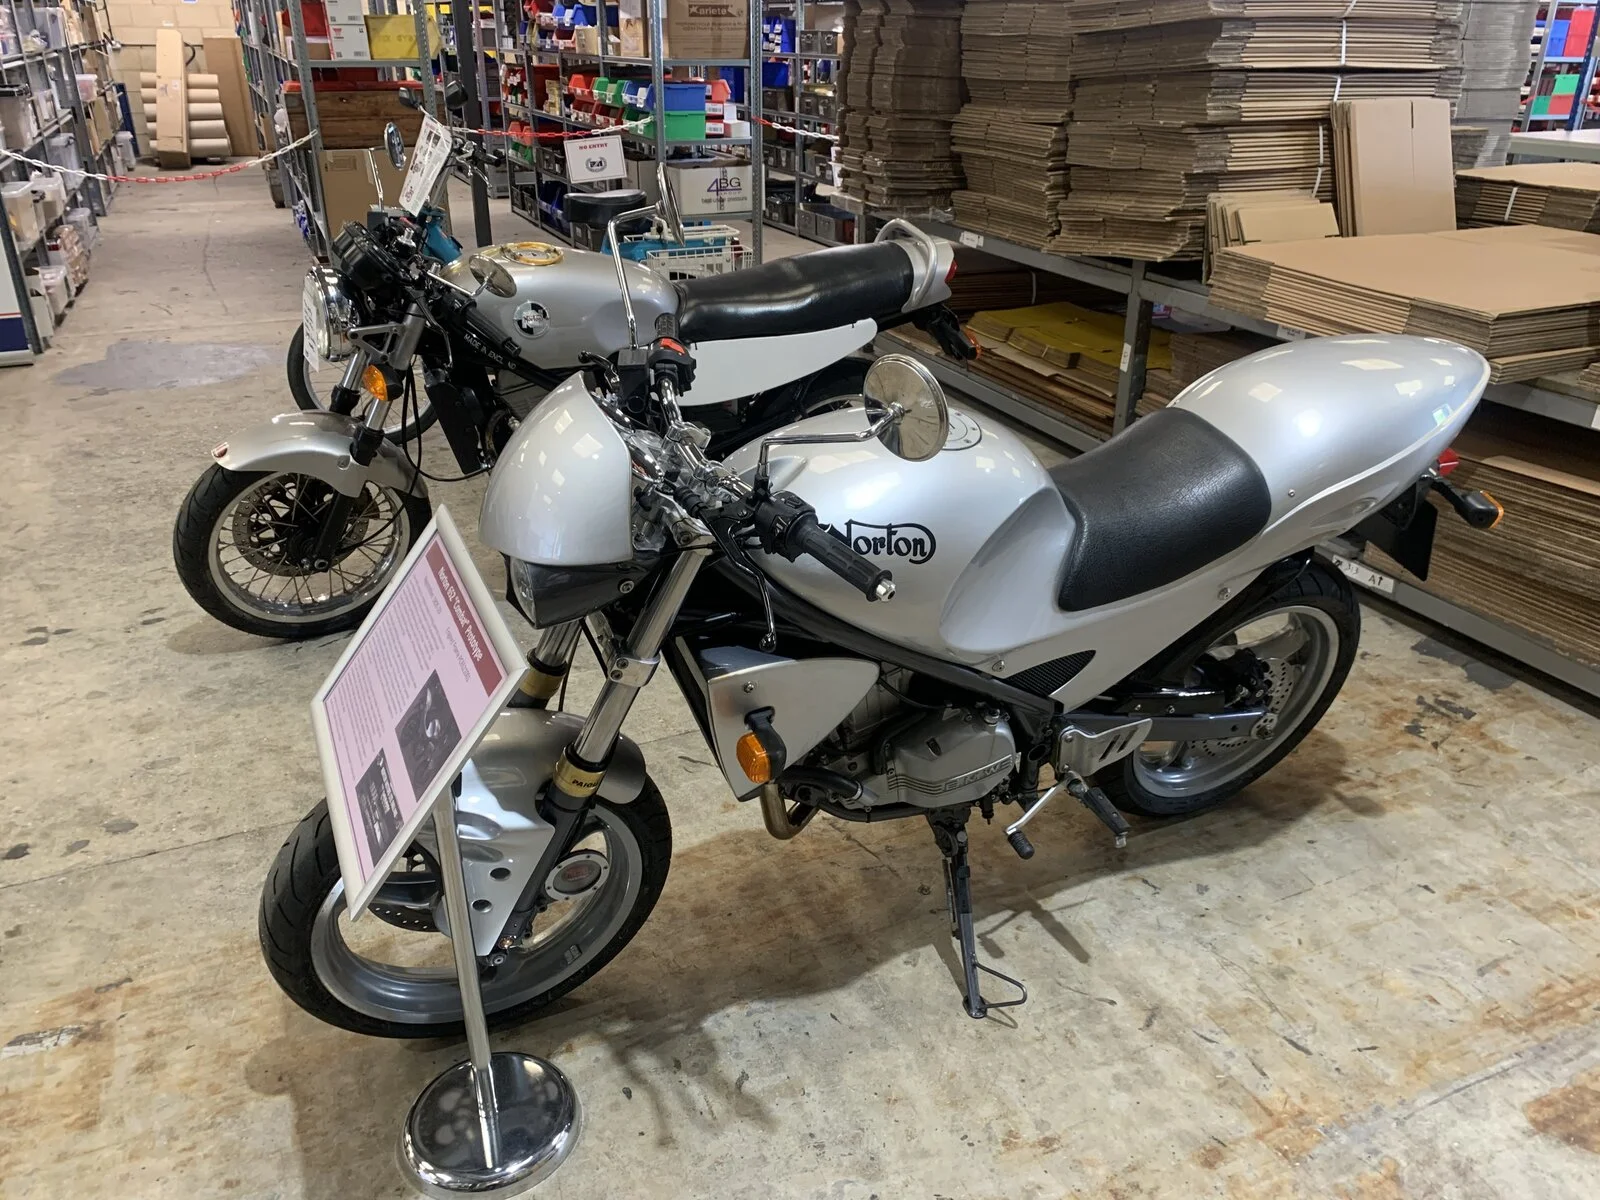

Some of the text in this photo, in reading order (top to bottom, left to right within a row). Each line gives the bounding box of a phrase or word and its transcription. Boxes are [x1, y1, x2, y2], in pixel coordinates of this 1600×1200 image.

[699, 6, 728, 16] ariete
[463, 333, 482, 349] MADE
[819, 518, 937, 565] Norton
[438, 566, 451, 592] Norton
[464, 624, 484, 662] Prototype
